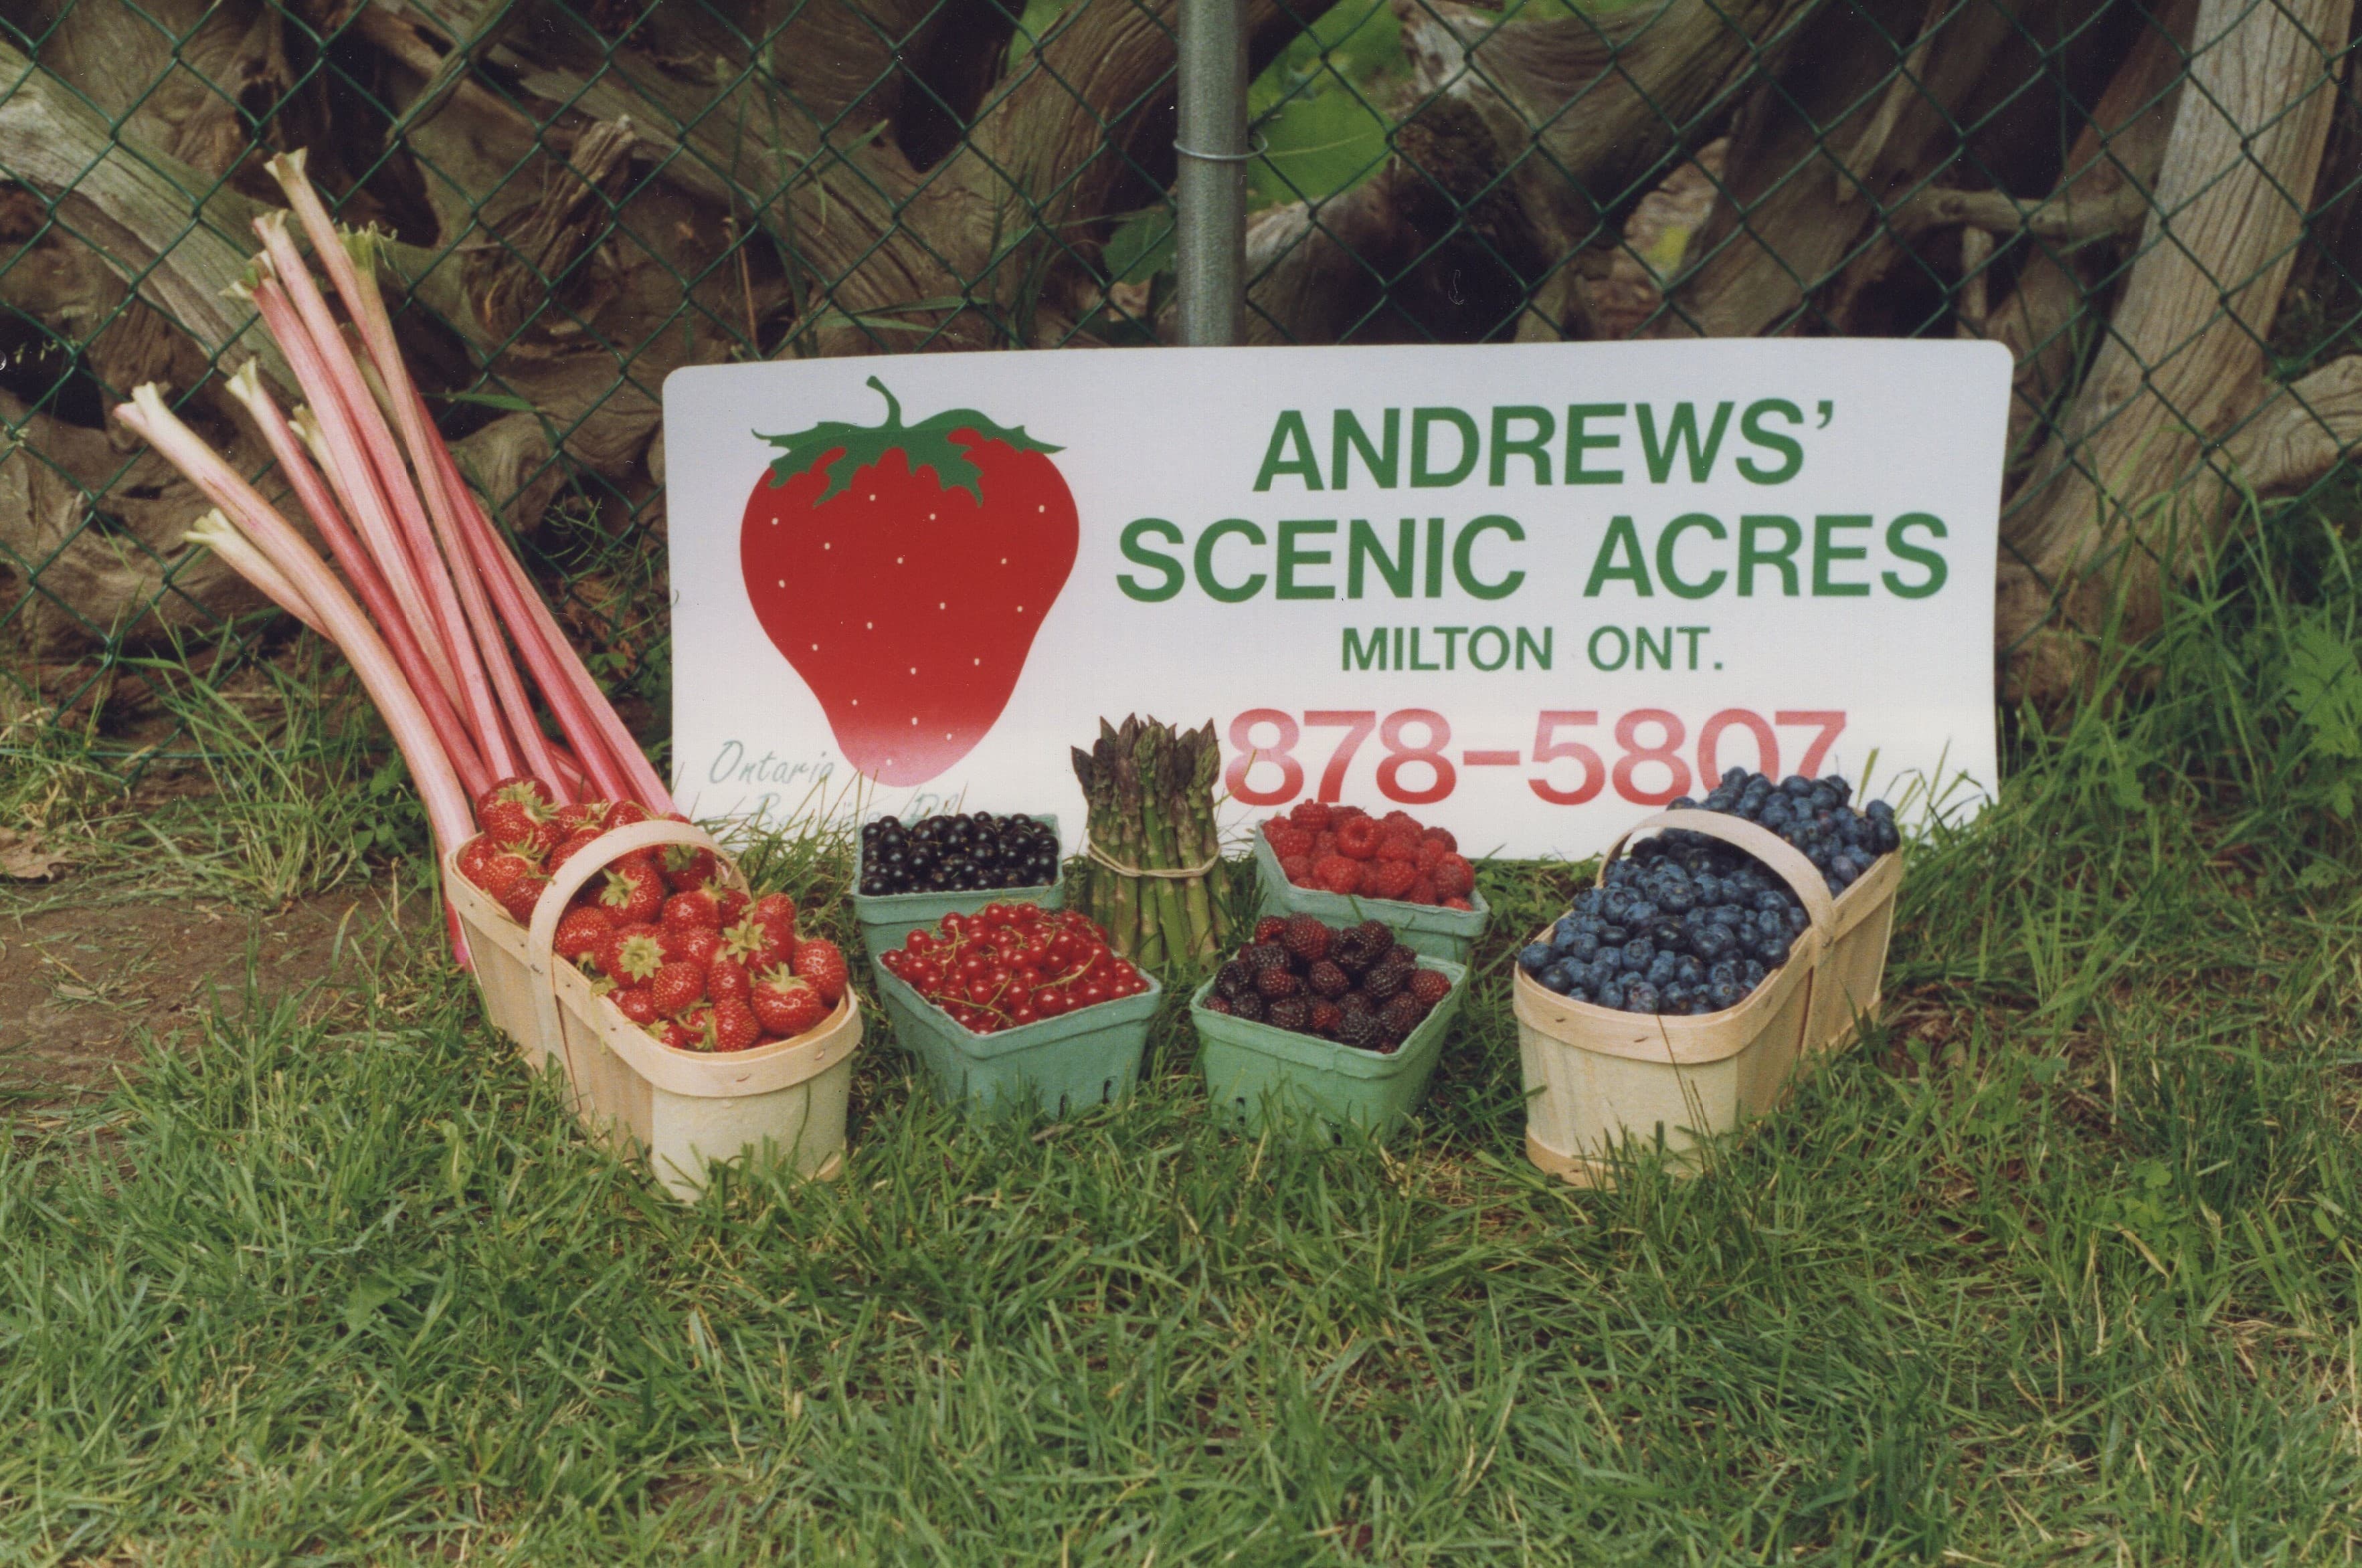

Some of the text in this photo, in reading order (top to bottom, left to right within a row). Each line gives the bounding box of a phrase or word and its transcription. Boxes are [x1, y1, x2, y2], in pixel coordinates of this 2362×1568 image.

[1253, 397, 1834, 491] ANDREWS'
[1116, 512, 1949, 602] SCENIC ACRES
[1342, 625, 1724, 670] MILTON ONT.
[1225, 708, 1847, 805] 878-5807
